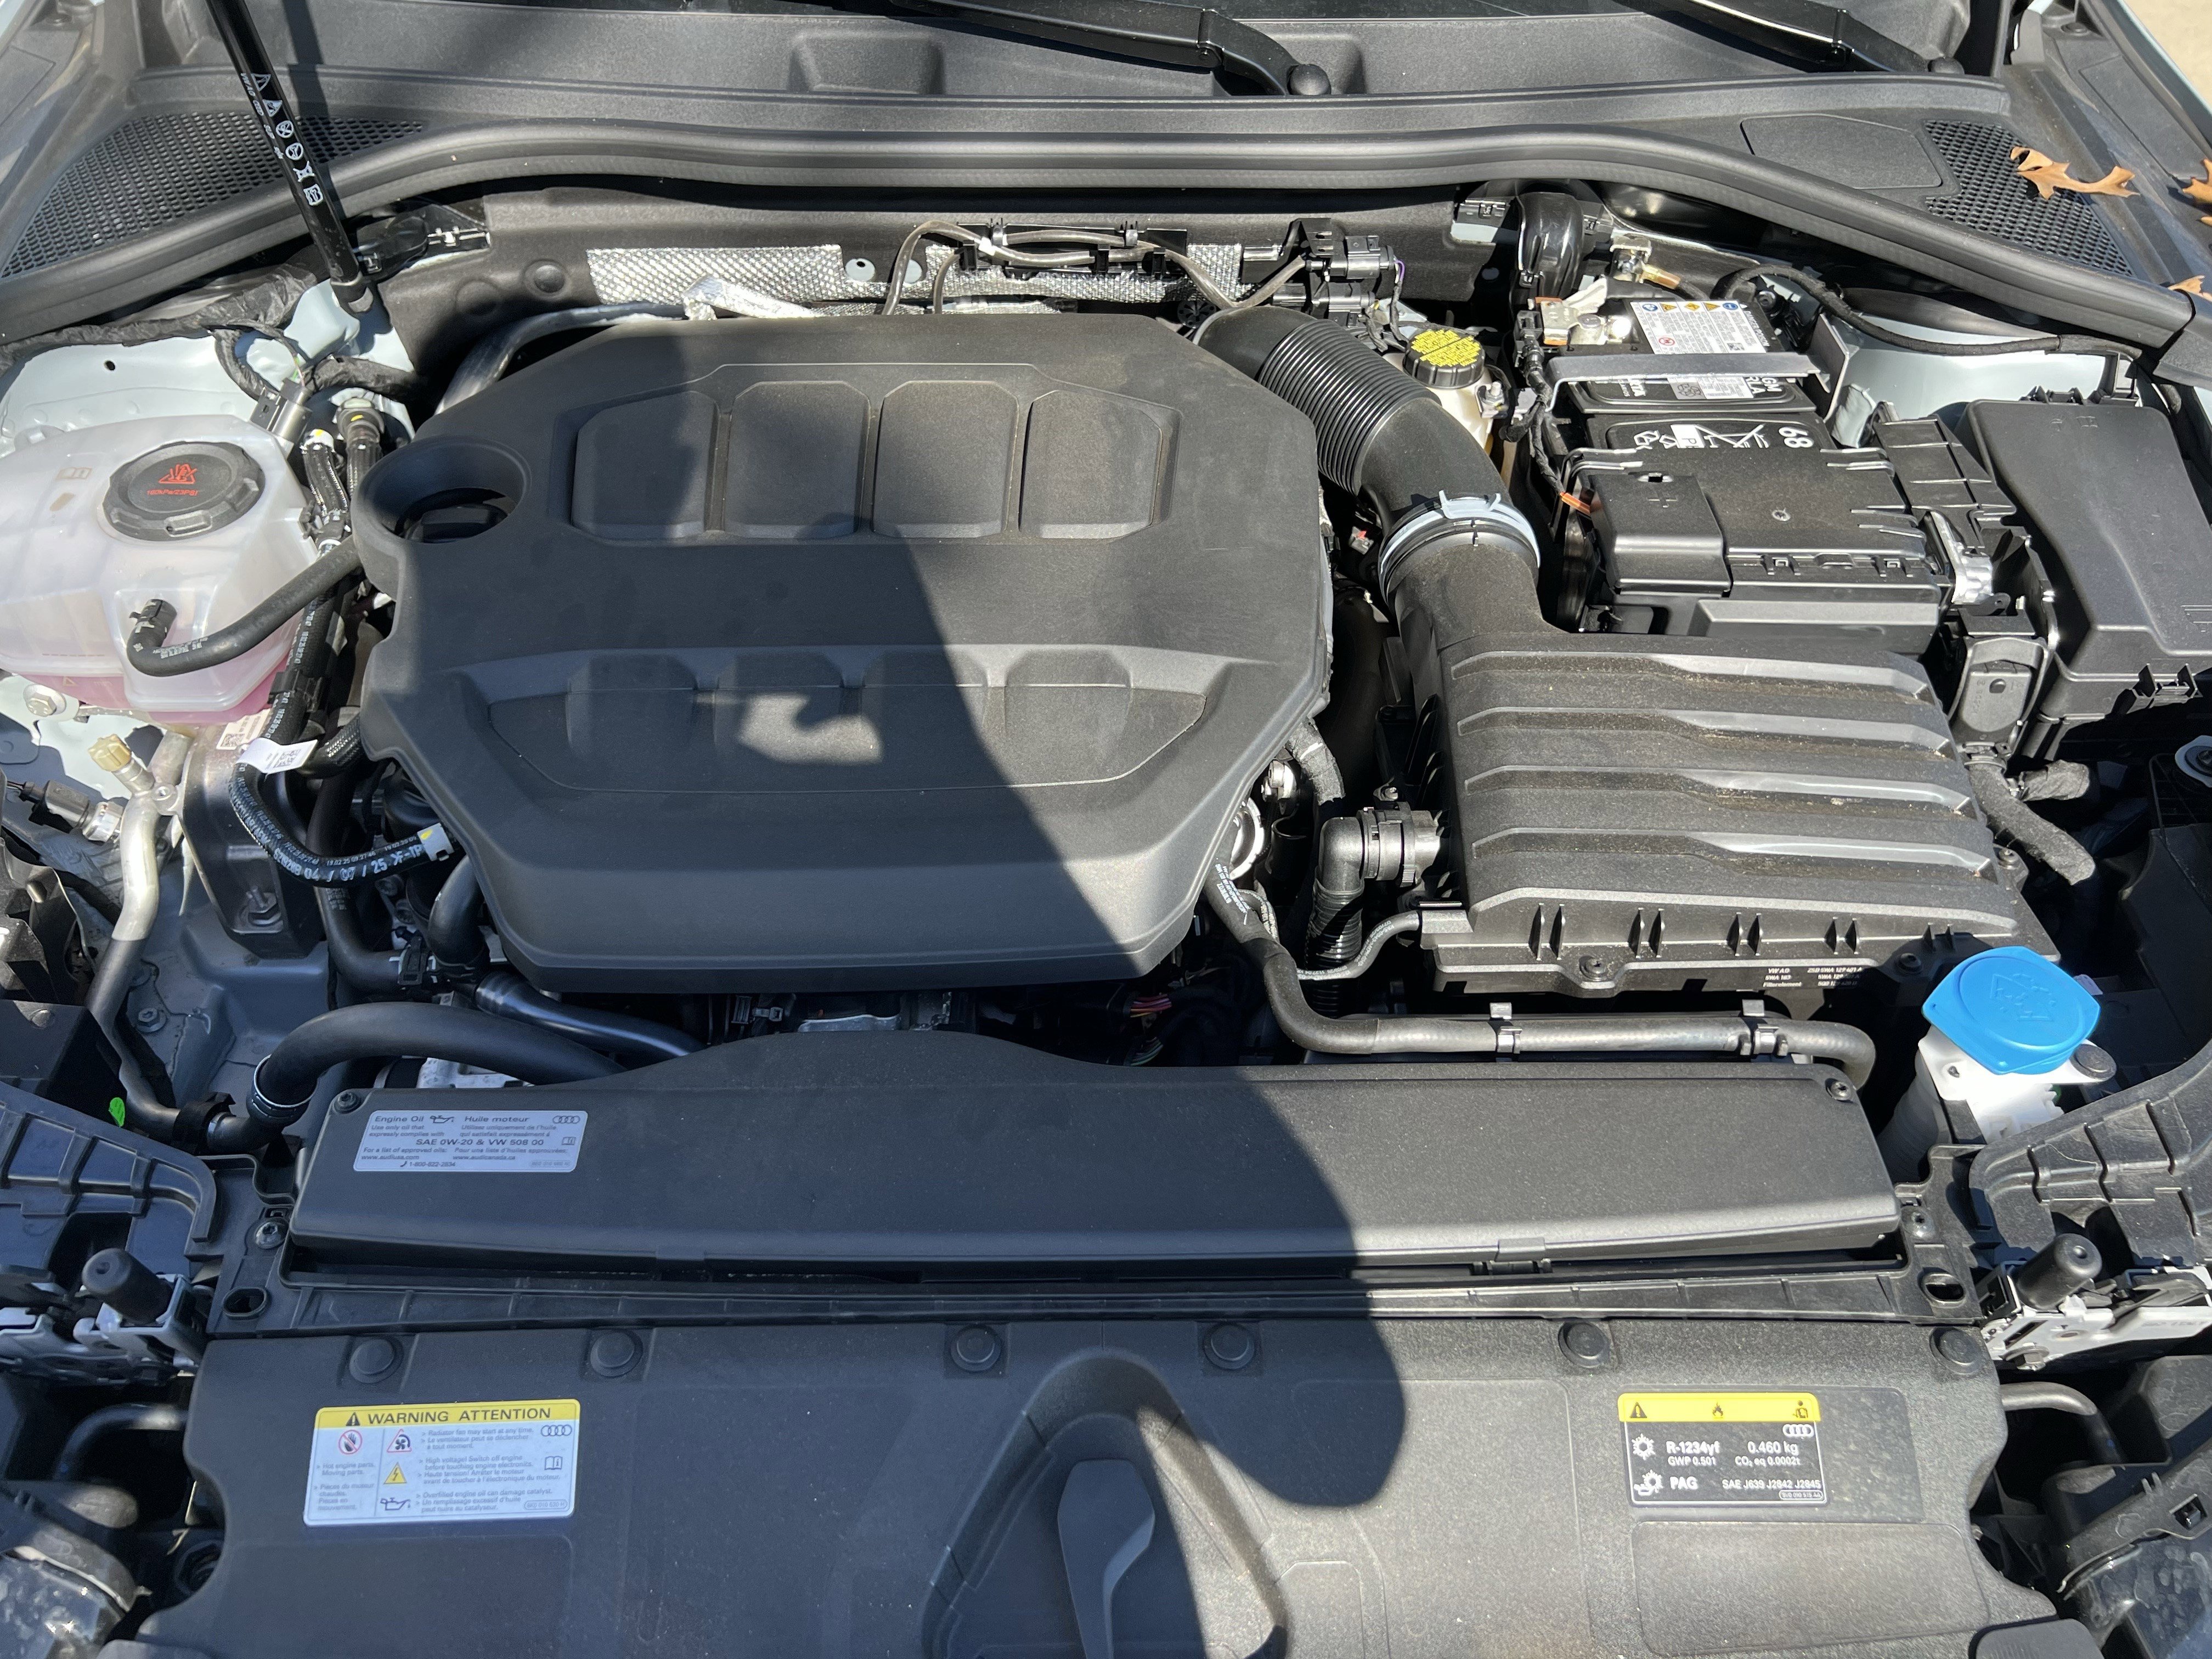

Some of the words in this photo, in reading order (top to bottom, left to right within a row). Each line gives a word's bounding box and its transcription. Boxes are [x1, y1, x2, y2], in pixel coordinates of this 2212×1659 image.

[1778, 426, 1814, 449] 68
[371, 858, 387, 874] 25
[368, 1411, 449, 1425] WARNING
[459, 1407, 551, 1421] ATTENTION
[1666, 1441, 1720, 1454] R-1234yf
[1747, 1441, 1780, 1453] 0.460
[1784, 1441, 1799, 1455] kg
[1668, 1457, 1691, 1466] GWP
[1692, 1457, 1717, 1466] 0.501
[1755, 1458, 1766, 1467] eq
[1767, 1457, 1801, 1466] 0.0002t
[1669, 1476, 1699, 1490] PAG
[1722, 1479, 1741, 1489] SAE
[1743, 1479, 1764, 1489] J639
[1766, 1479, 1793, 1489] J2842
[1795, 1479, 1821, 1489] J2845
[433, 1498, 472, 1506] remplissage
